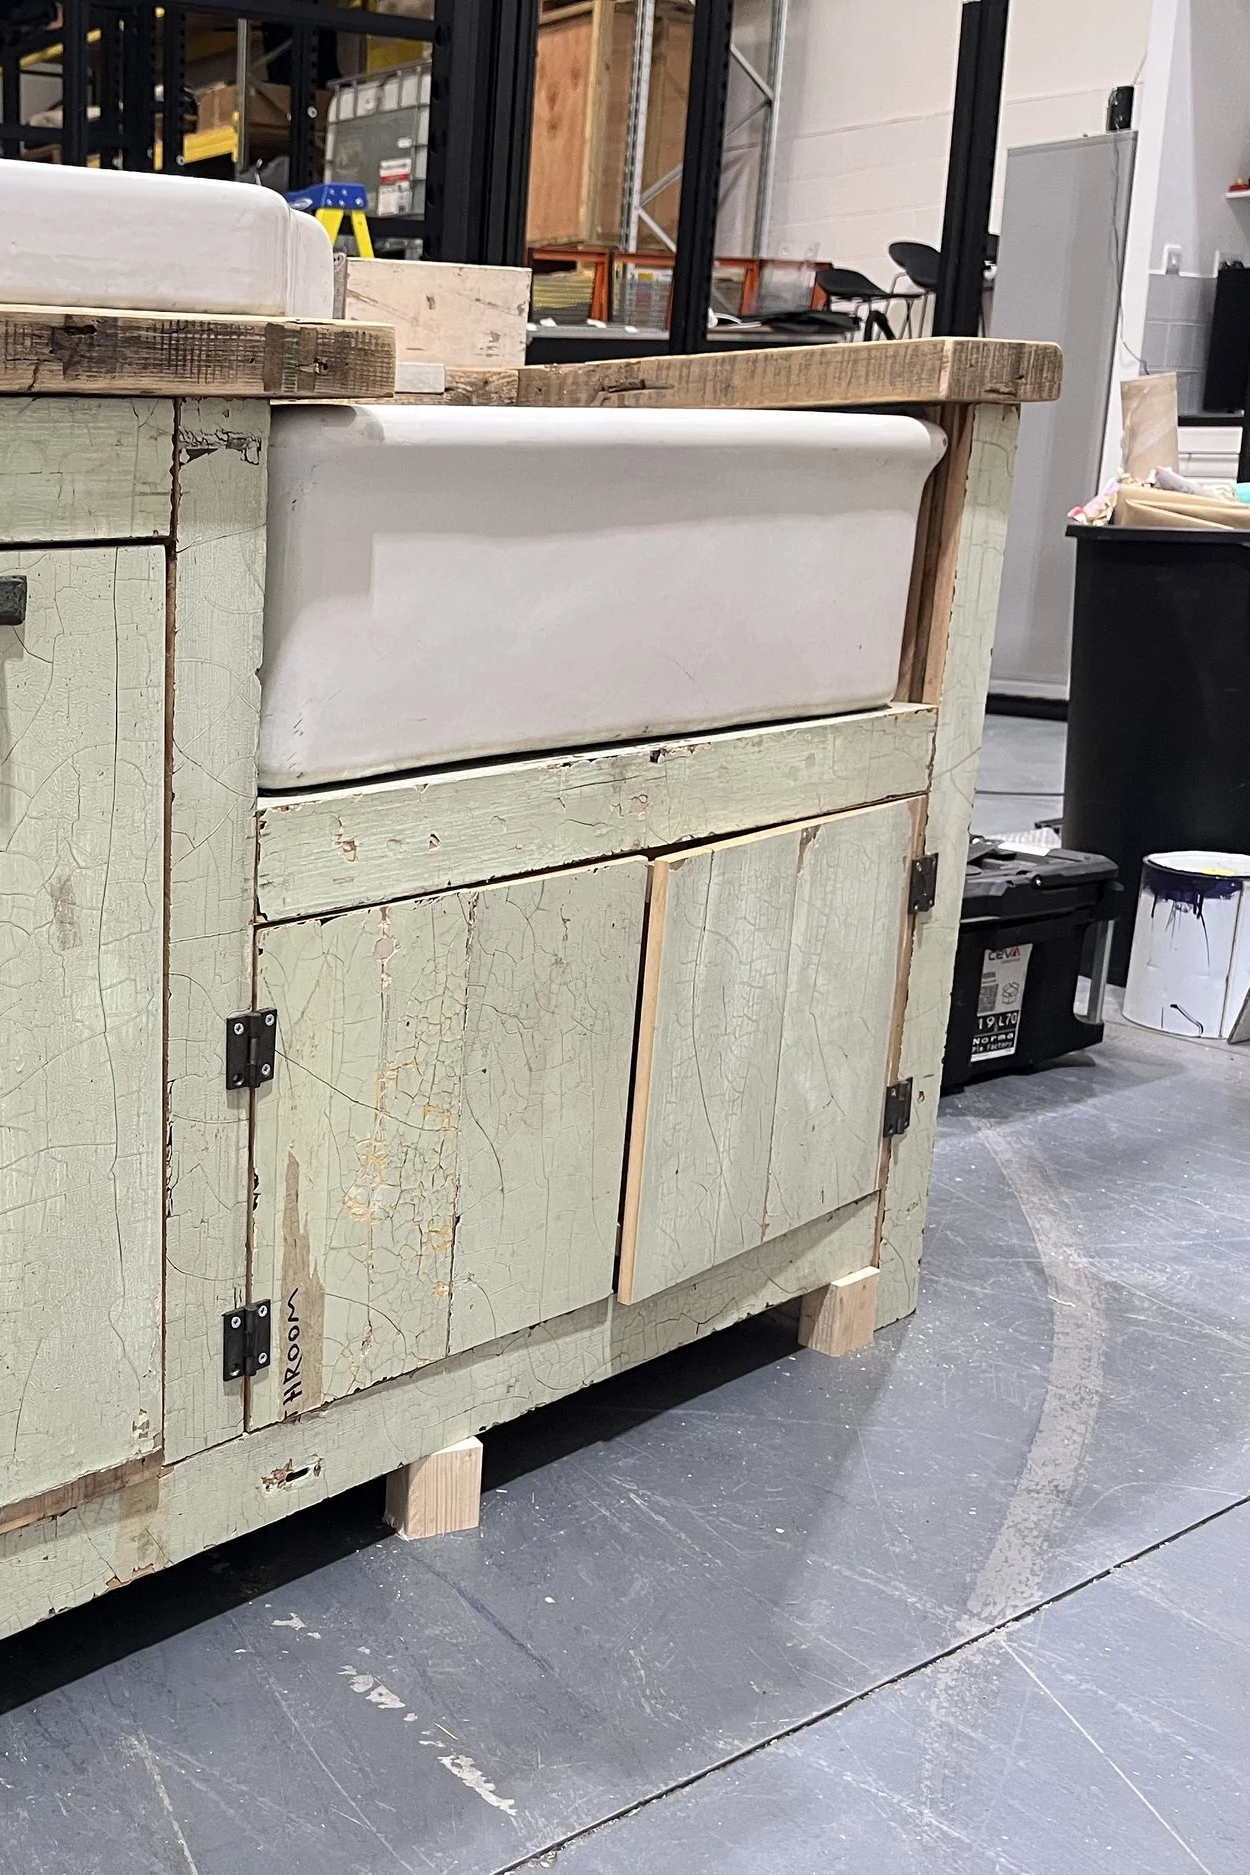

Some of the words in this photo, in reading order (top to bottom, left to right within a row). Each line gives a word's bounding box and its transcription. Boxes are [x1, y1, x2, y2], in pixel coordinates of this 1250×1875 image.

[979, 1016, 994, 1029] 19
[999, 1013, 1017, 1026] L70
[972, 1033, 1013, 1045] Norma
